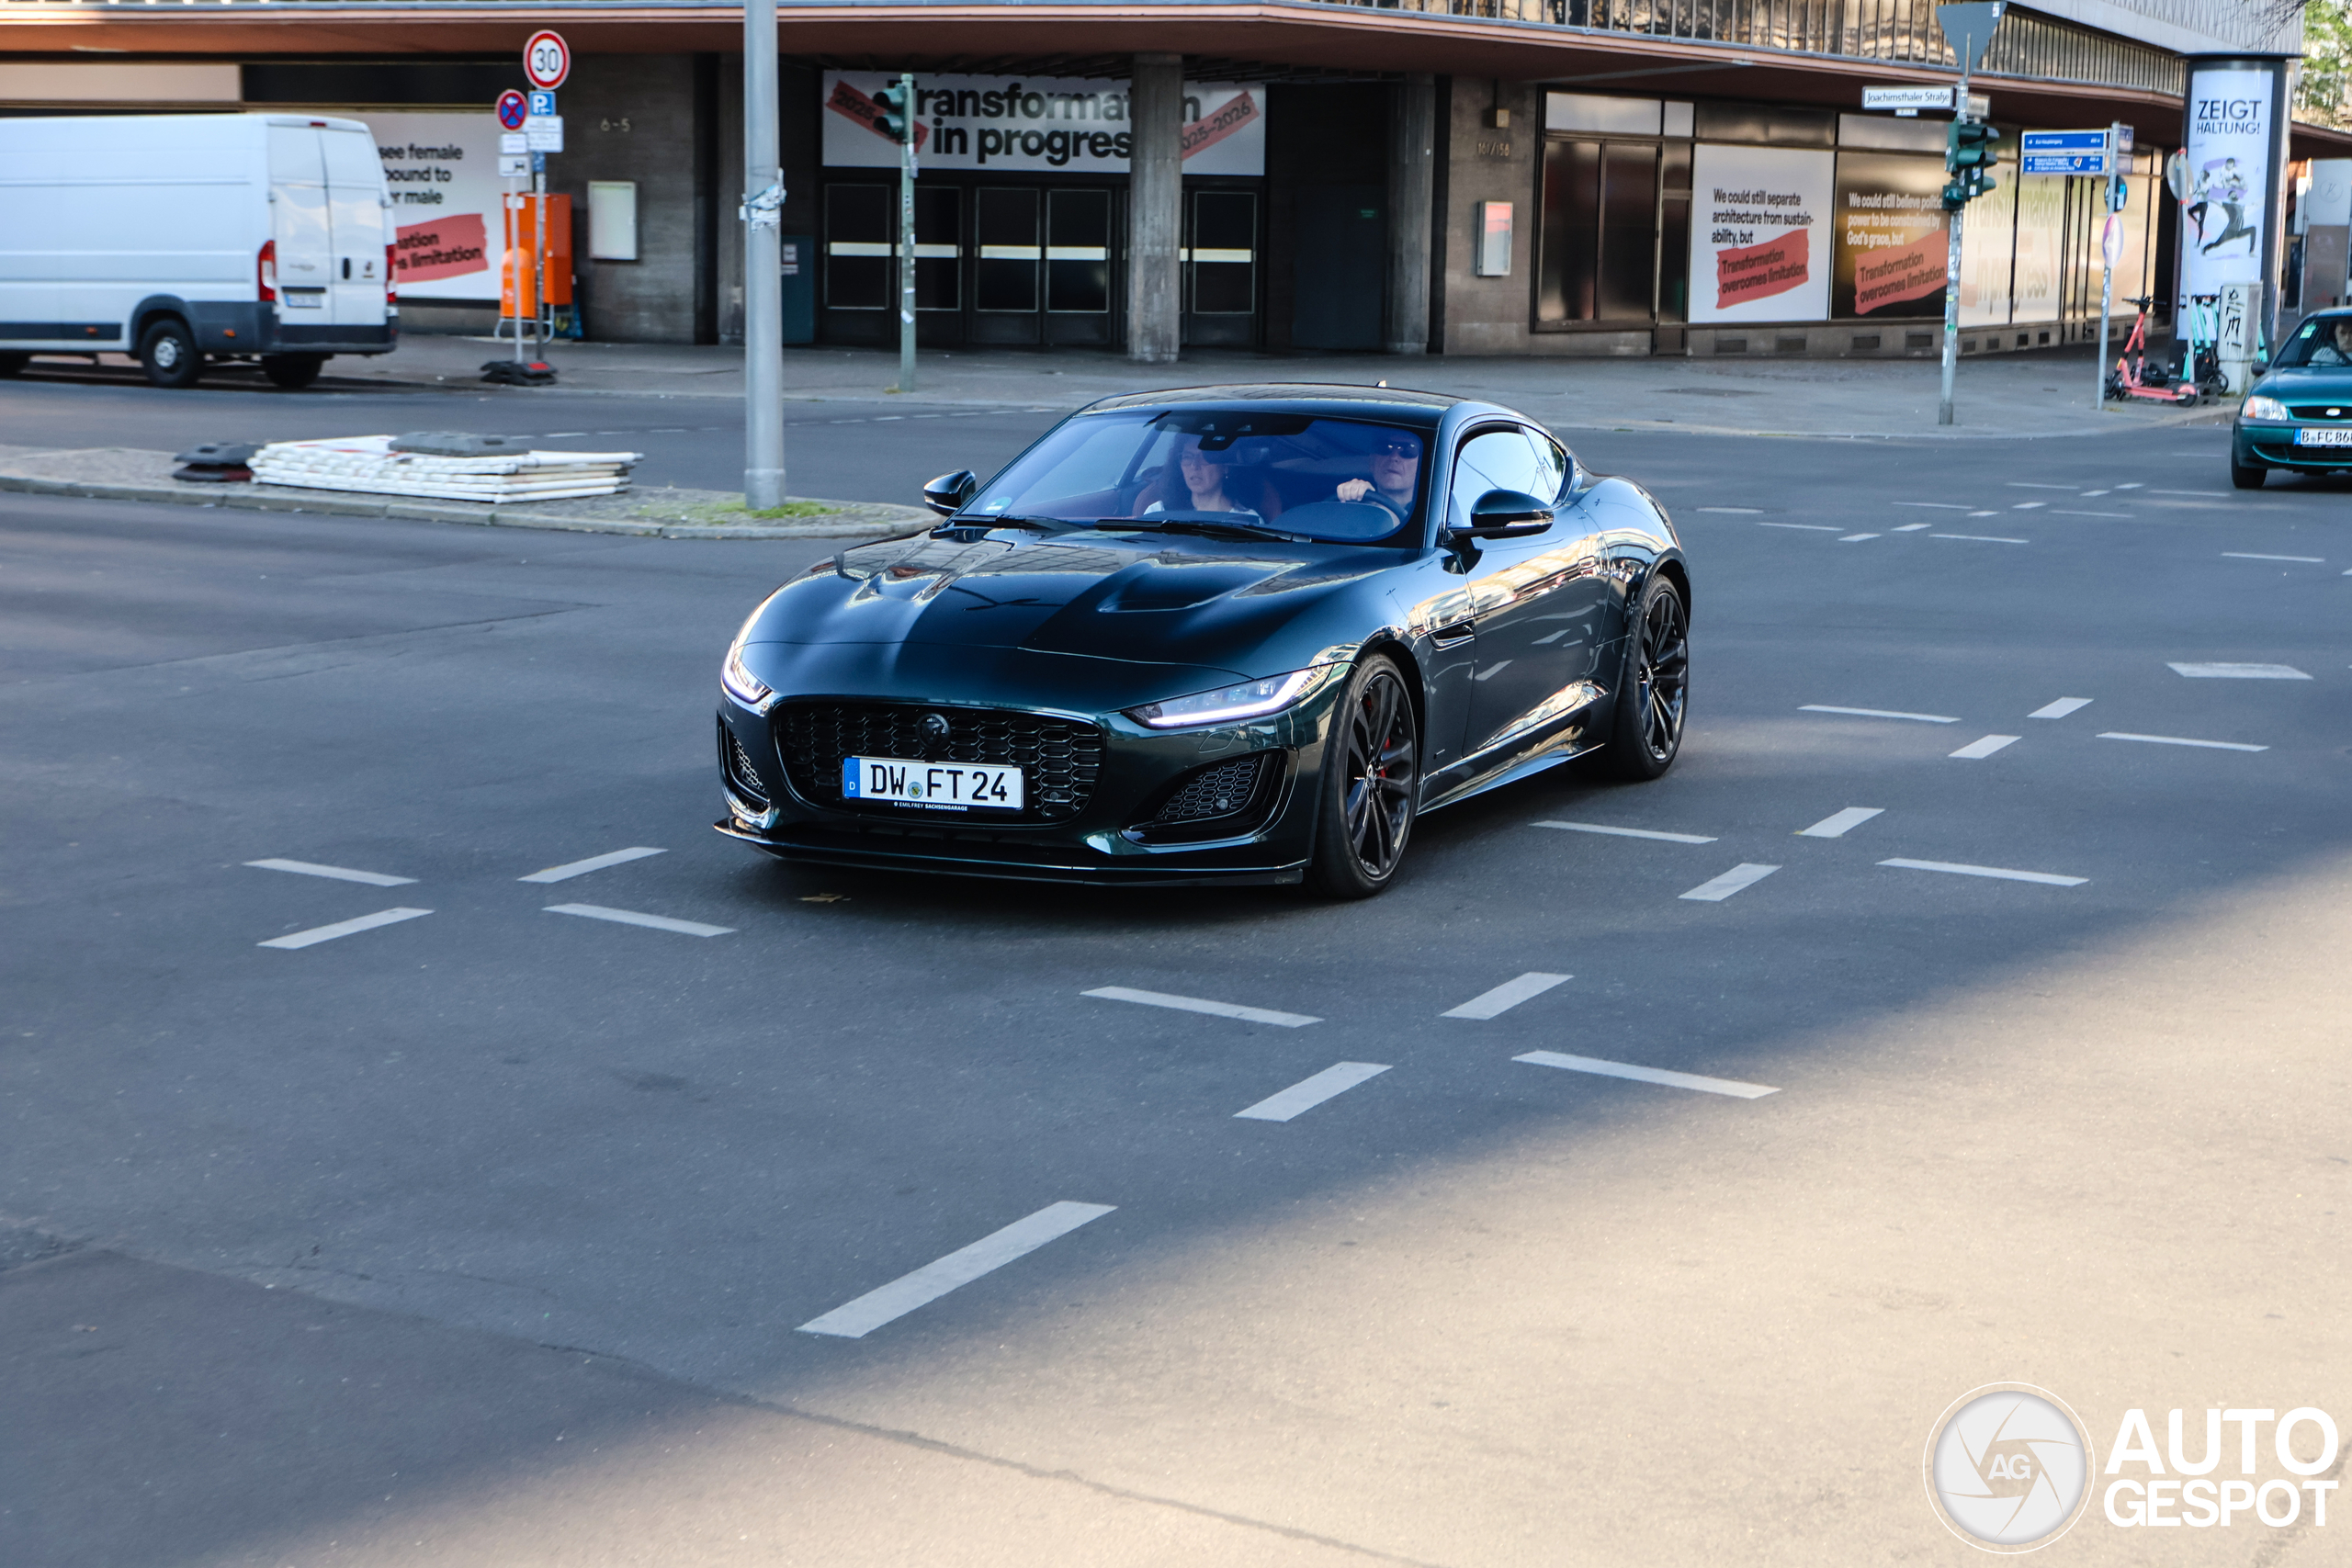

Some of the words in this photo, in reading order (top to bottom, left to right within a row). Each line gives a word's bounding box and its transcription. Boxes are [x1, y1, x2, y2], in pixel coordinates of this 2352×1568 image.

[535, 48, 560, 72] 30
[1866, 92, 1923, 104] Joachimsthaler
[1925, 92, 1950, 104] Straße
[2199, 100, 2262, 120] ZEIGT
[2197, 121, 2261, 135] HALTUNG!
[408, 142, 463, 160] female
[933, 117, 967, 154] in
[978, 128, 1131, 166] progres
[435, 167, 452, 182] to
[405, 189, 443, 204] male
[1713, 188, 1727, 203] We
[1728, 189, 1750, 204] could
[1751, 189, 1766, 205] still
[1768, 192, 1802, 209] separate
[1849, 192, 1861, 208] We
[1861, 193, 1882, 209] could
[1883, 193, 1895, 209] still
[1896, 194, 1920, 209] believe
[1921, 195, 1942, 211] politic
[1713, 209, 1762, 224] architecture
[1763, 210, 1782, 225] from
[1783, 211, 1814, 226] sustain-
[1848, 213, 1871, 230] power
[1871, 212, 1879, 227] to
[1880, 212, 1890, 227] be
[1891, 213, 1931, 228] constrained
[1931, 213, 1940, 231] by
[1712, 228, 1738, 247] ability,
[1739, 229, 1753, 243] but
[1869, 232, 1891, 249] grace,
[1892, 231, 1904, 245] but
[411, 245, 482, 268] limitation
[1722, 248, 1785, 275] Transformation
[1860, 253, 1924, 283] Transformation
[1722, 272, 1767, 294] overcomes
[1769, 262, 1805, 283] limitation
[1860, 278, 1905, 303] overcomes
[1907, 265, 1945, 288] limitation
[2302, 432, 2309, 443] B
[2318, 432, 2333, 443] FC
[2335, 432, 2352, 443] 86
[849, 782, 855, 790] D
[870, 764, 906, 795] DW
[927, 768, 964, 799] FT
[972, 772, 1007, 801] 24
[925, 803, 967, 811] SACHSENGARAGE
